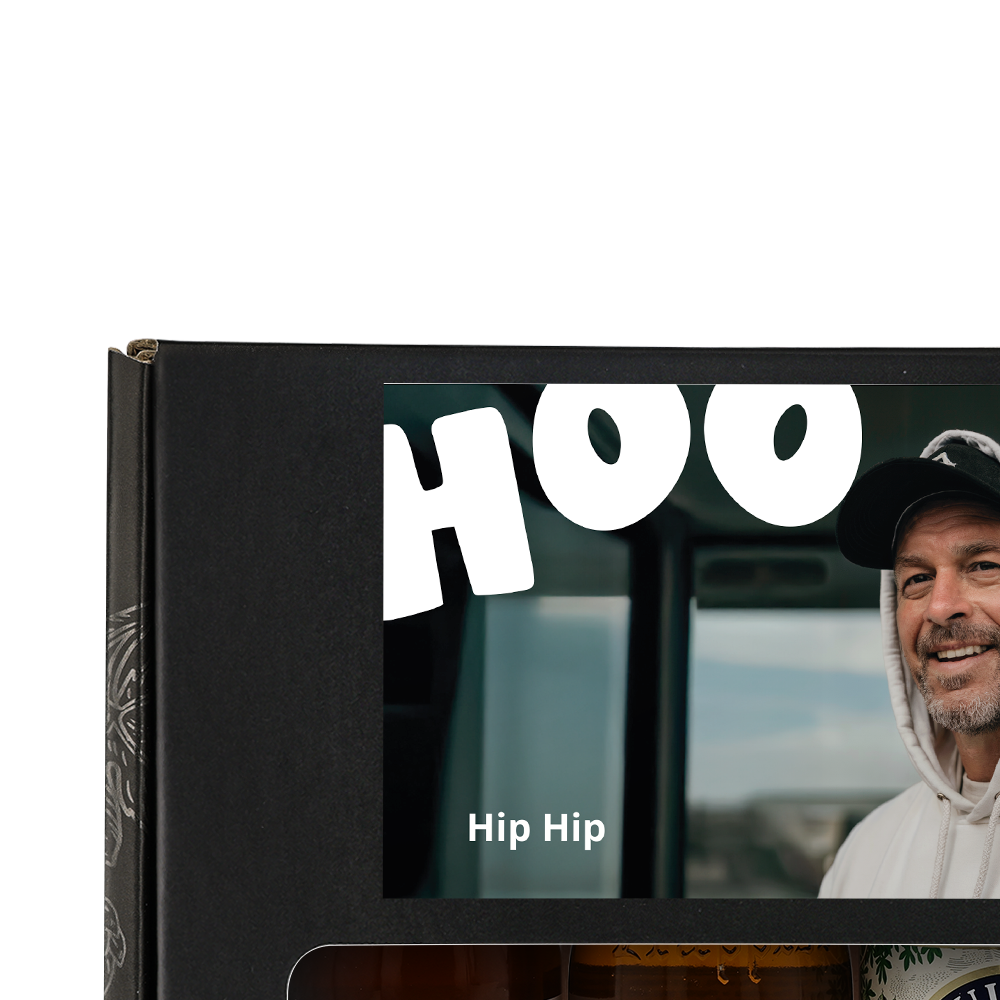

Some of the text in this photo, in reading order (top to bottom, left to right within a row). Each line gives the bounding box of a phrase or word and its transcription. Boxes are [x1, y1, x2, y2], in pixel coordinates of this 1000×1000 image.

[384, 384, 863, 621] HOO
[468, 812, 606, 849] Hip Hip
